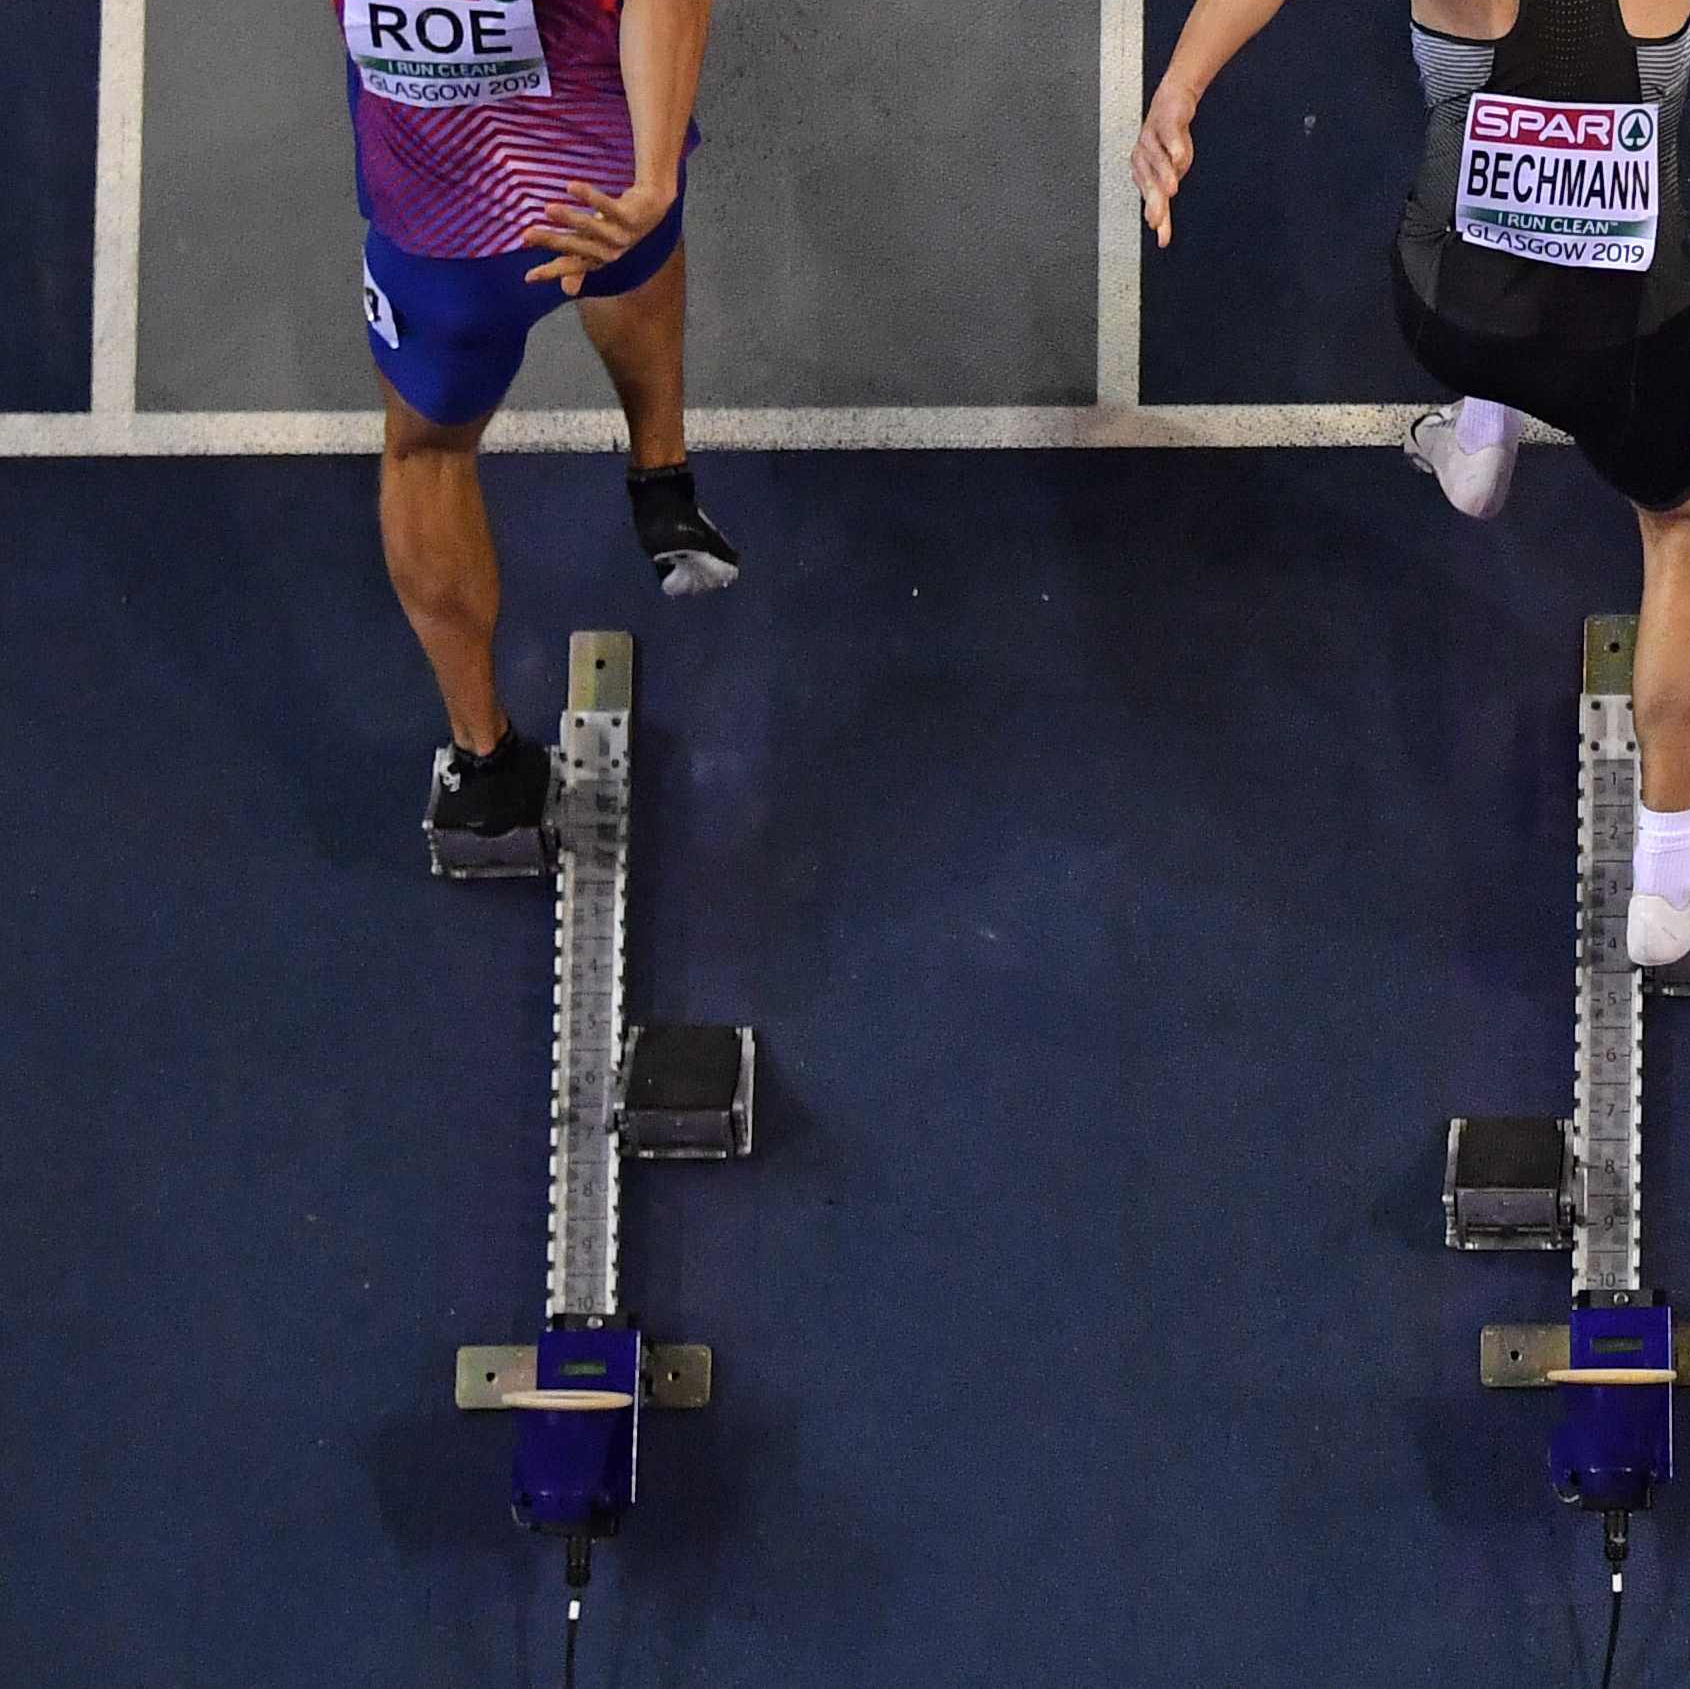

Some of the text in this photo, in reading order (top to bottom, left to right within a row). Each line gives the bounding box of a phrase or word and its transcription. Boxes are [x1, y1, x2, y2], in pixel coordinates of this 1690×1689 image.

[368, 3, 513, 55] ROE
[395, 62, 435, 77] RUN
[368, 72, 541, 102] GLASGOW 2019
[1474, 105, 1611, 145] SPAR
[1466, 149, 1649, 210] BECHMANN
[1507, 214, 1547, 230] RUN
[1467, 223, 1645, 264] GLASGOW 2019
[1608, 825, 1618, 840] 2
[1608, 881, 1617, 896] 3
[1607, 992, 1617, 1007] 5
[1605, 1047, 1616, 1062] 6
[1605, 1103, 1615, 1118] 7
[1604, 1159, 1615, 1175] 8
[1603, 1216, 1614, 1231] 9
[1599, 1272, 1616, 1288] 10
